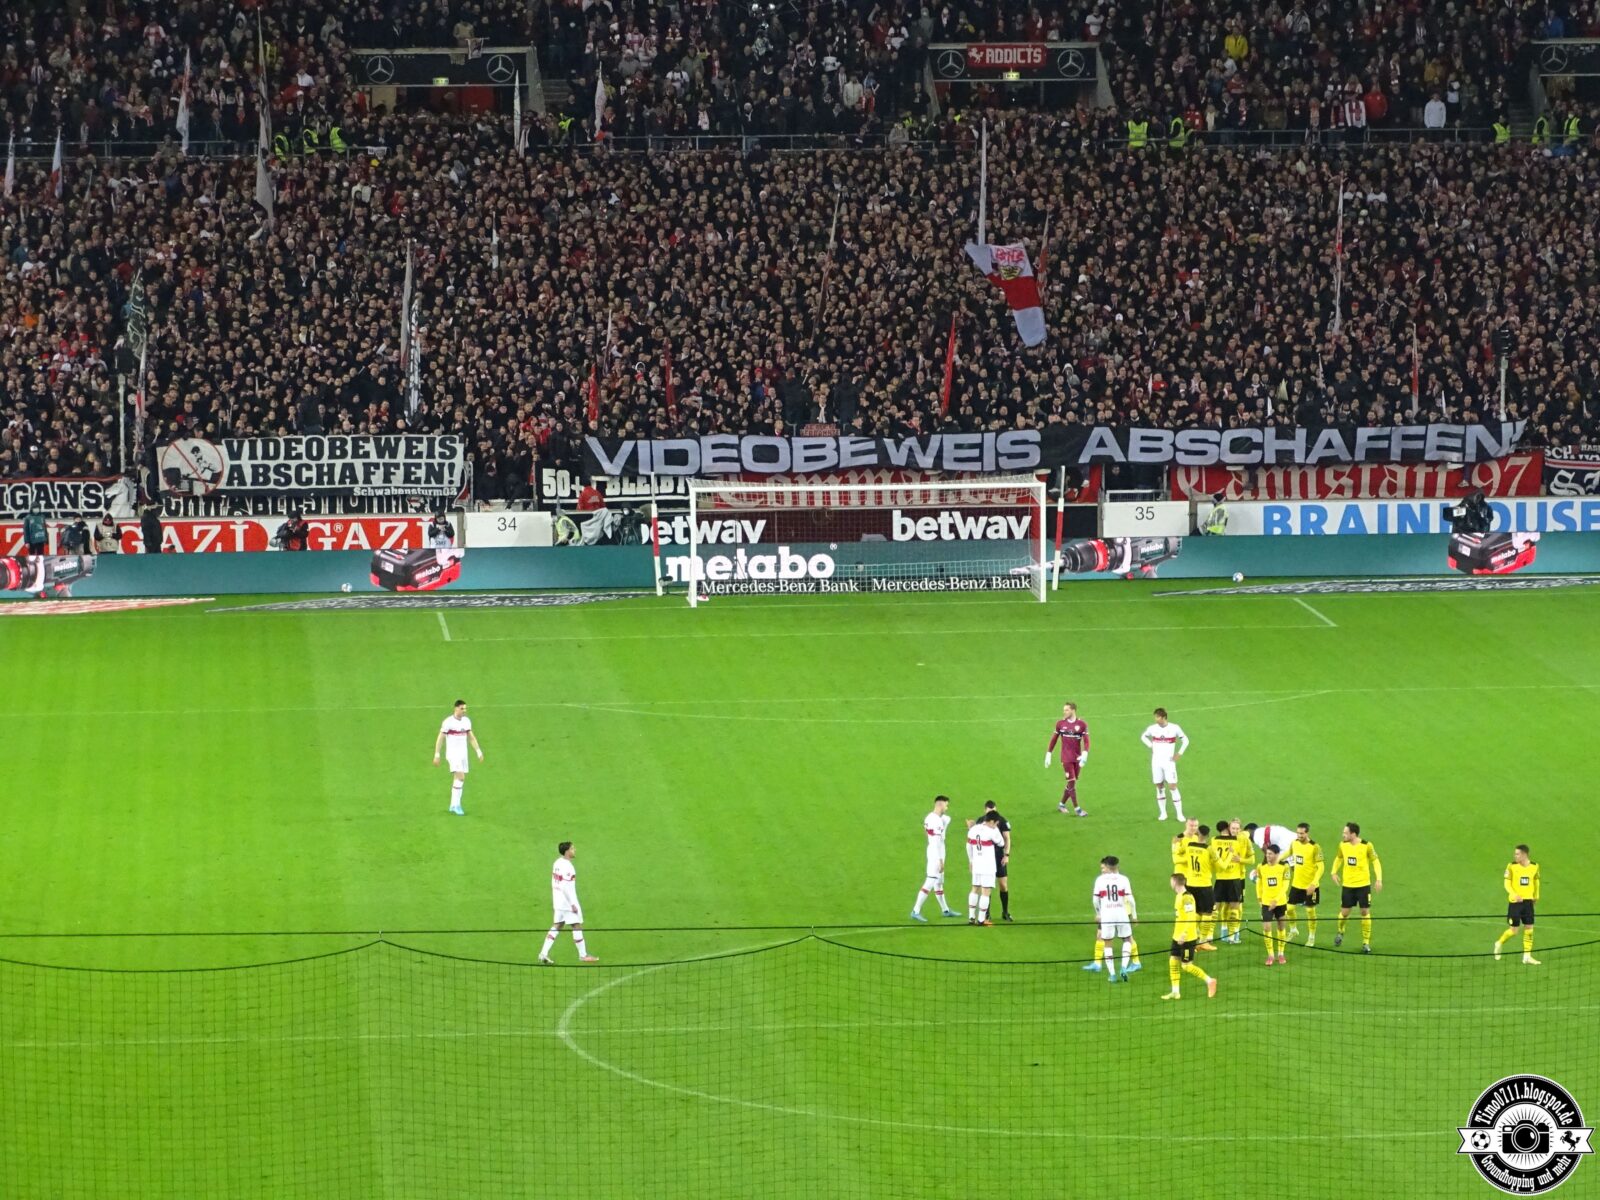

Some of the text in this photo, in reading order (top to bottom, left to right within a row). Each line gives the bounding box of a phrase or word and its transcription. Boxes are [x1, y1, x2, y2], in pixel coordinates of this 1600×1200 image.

[986, 48, 1041, 63] ADDICTS
[223, 436, 458, 462] VIDEOBEWEIS
[584, 428, 1042, 477] VIDEOBEWEIS
[225, 462, 456, 488] ABSCHAFFEN!
[1471, 456, 1534, 497] 97
[1134, 506, 1155, 521] 35
[497, 517, 518, 532] 34
[891, 510, 1032, 542] betway
[702, 578, 860, 594] Mercedes-Benz Bank
[873, 575, 1031, 592] Mercedes-Benz Bank
[1191, 855, 1201, 872] 16
[1106, 884, 1118, 902] 18
